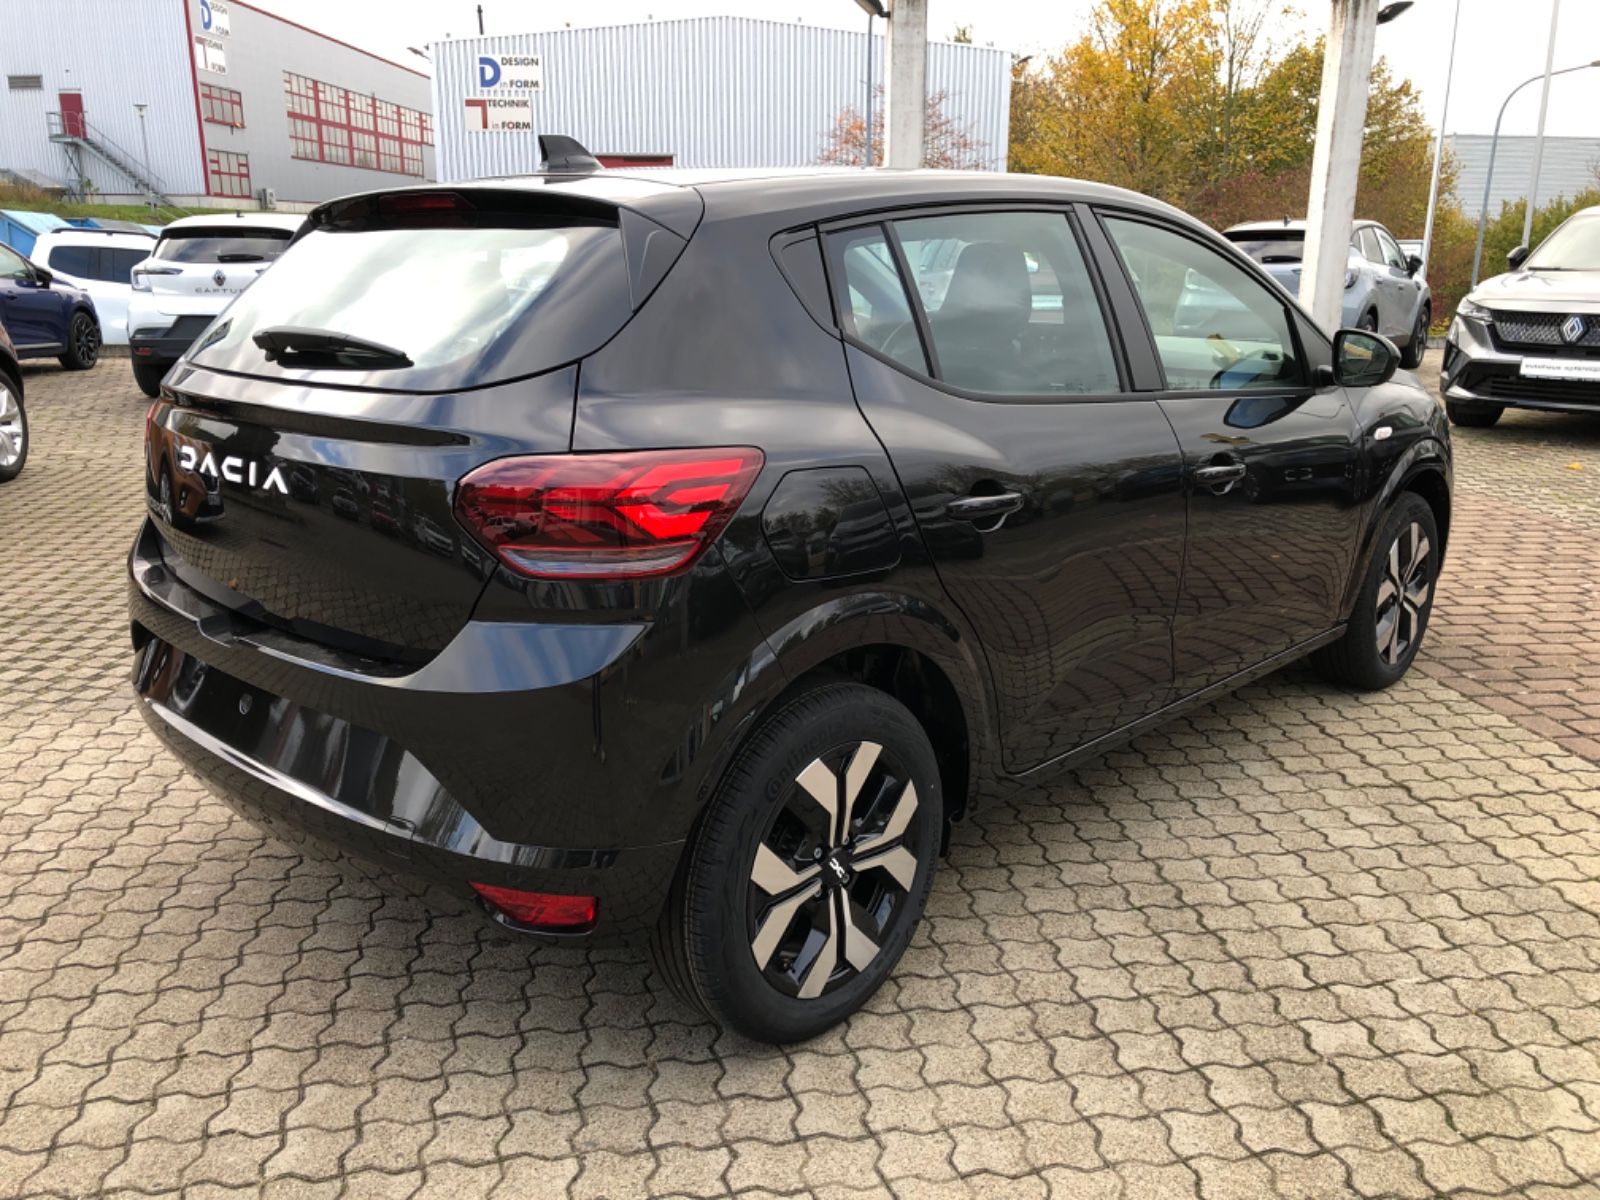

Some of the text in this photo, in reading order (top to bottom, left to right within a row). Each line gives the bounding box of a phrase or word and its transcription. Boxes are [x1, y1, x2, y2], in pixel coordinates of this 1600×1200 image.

[501, 57, 539, 66] DESIGN
[509, 79, 539, 88] FORM
[487, 100, 529, 108] TECHNIK
[501, 121, 531, 130] FORM
[180, 444, 289, 495] DACIA
